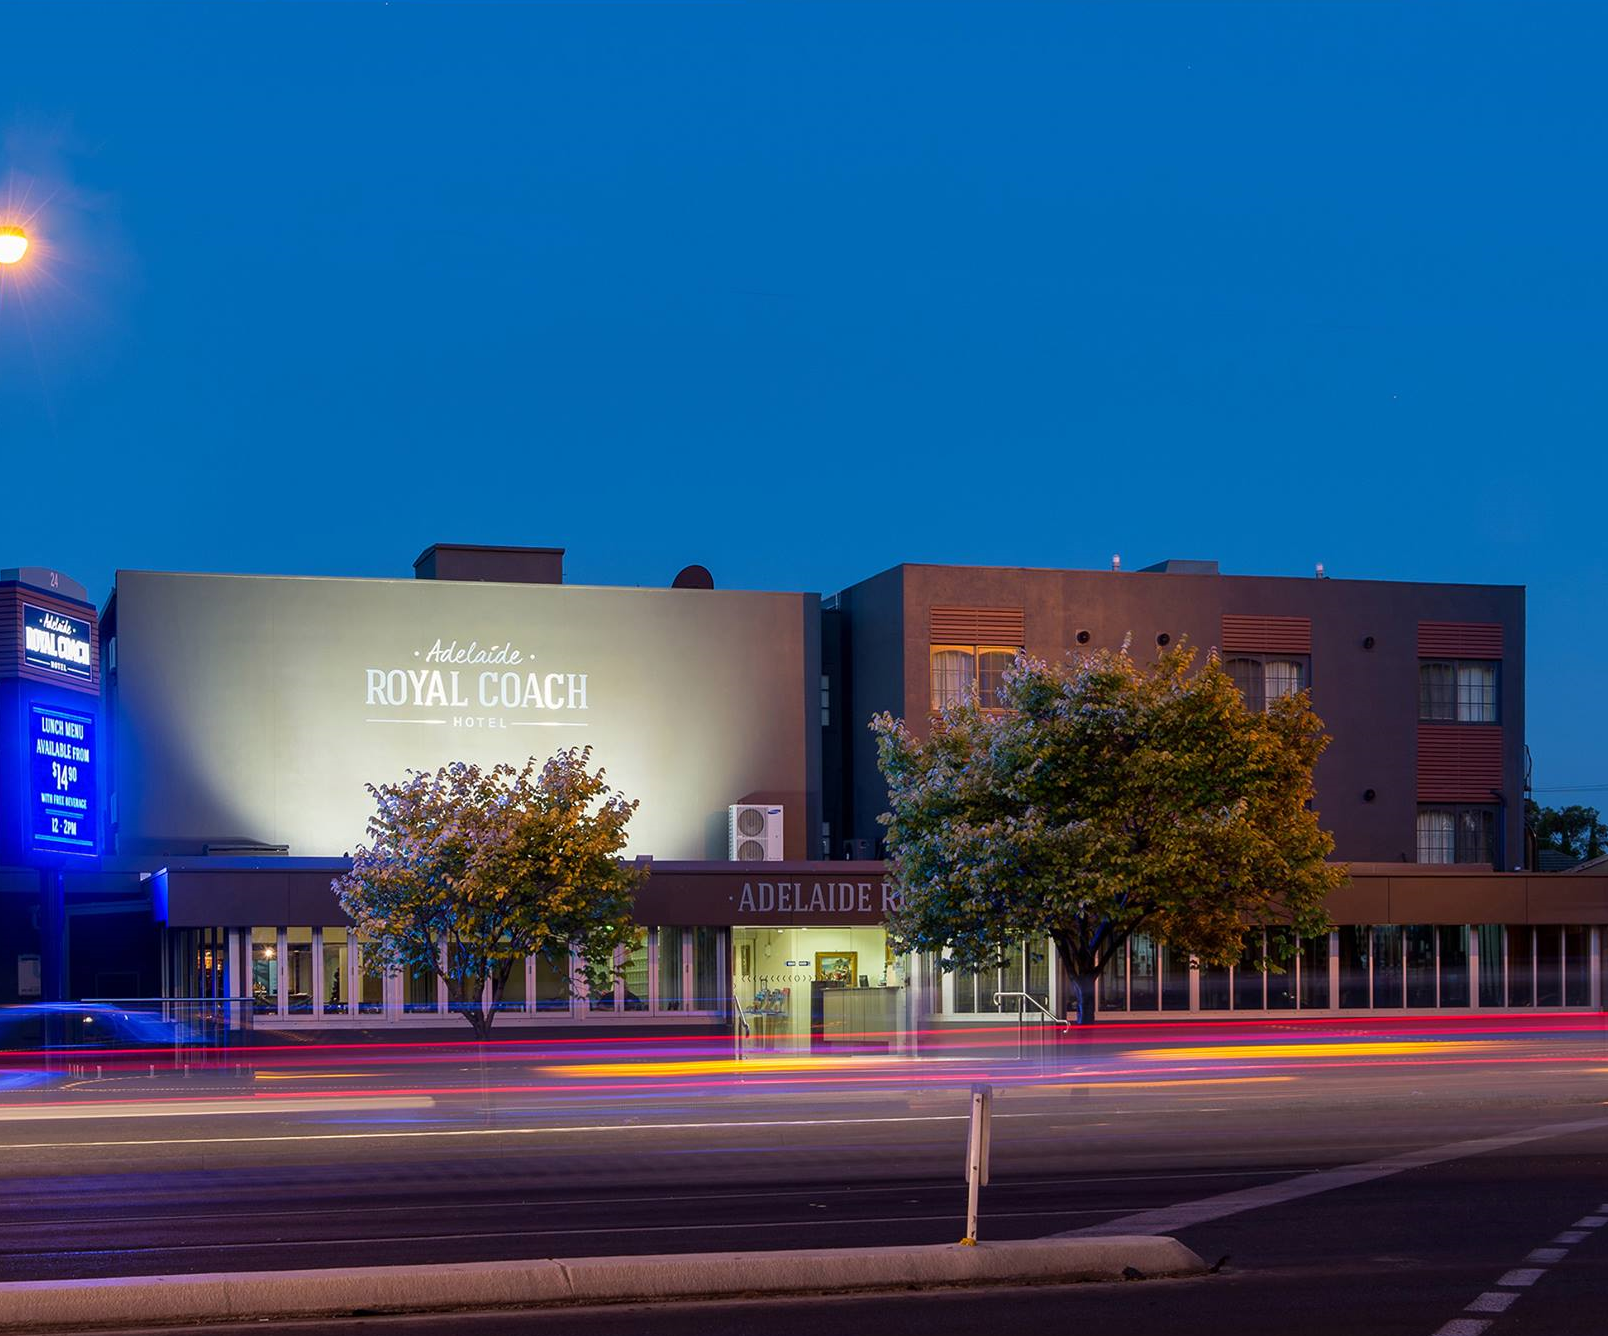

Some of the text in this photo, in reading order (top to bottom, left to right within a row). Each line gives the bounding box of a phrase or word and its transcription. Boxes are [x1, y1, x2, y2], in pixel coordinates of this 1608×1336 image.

[426, 639, 523, 664] Adelaide
[365, 669, 588, 710] ROYAL COACH
[42, 716, 84, 740] LUNCH MENU
[453, 716, 507, 728] HOTEL
[36, 738, 90, 763] AVAILABLE FROM
[41, 792, 53, 804] WITH
[53, 794, 65, 806] FREE
[52, 817, 59, 833] 12
[63, 820, 77, 836] 2PM
[738, 883, 872, 912] ADELAIDE
